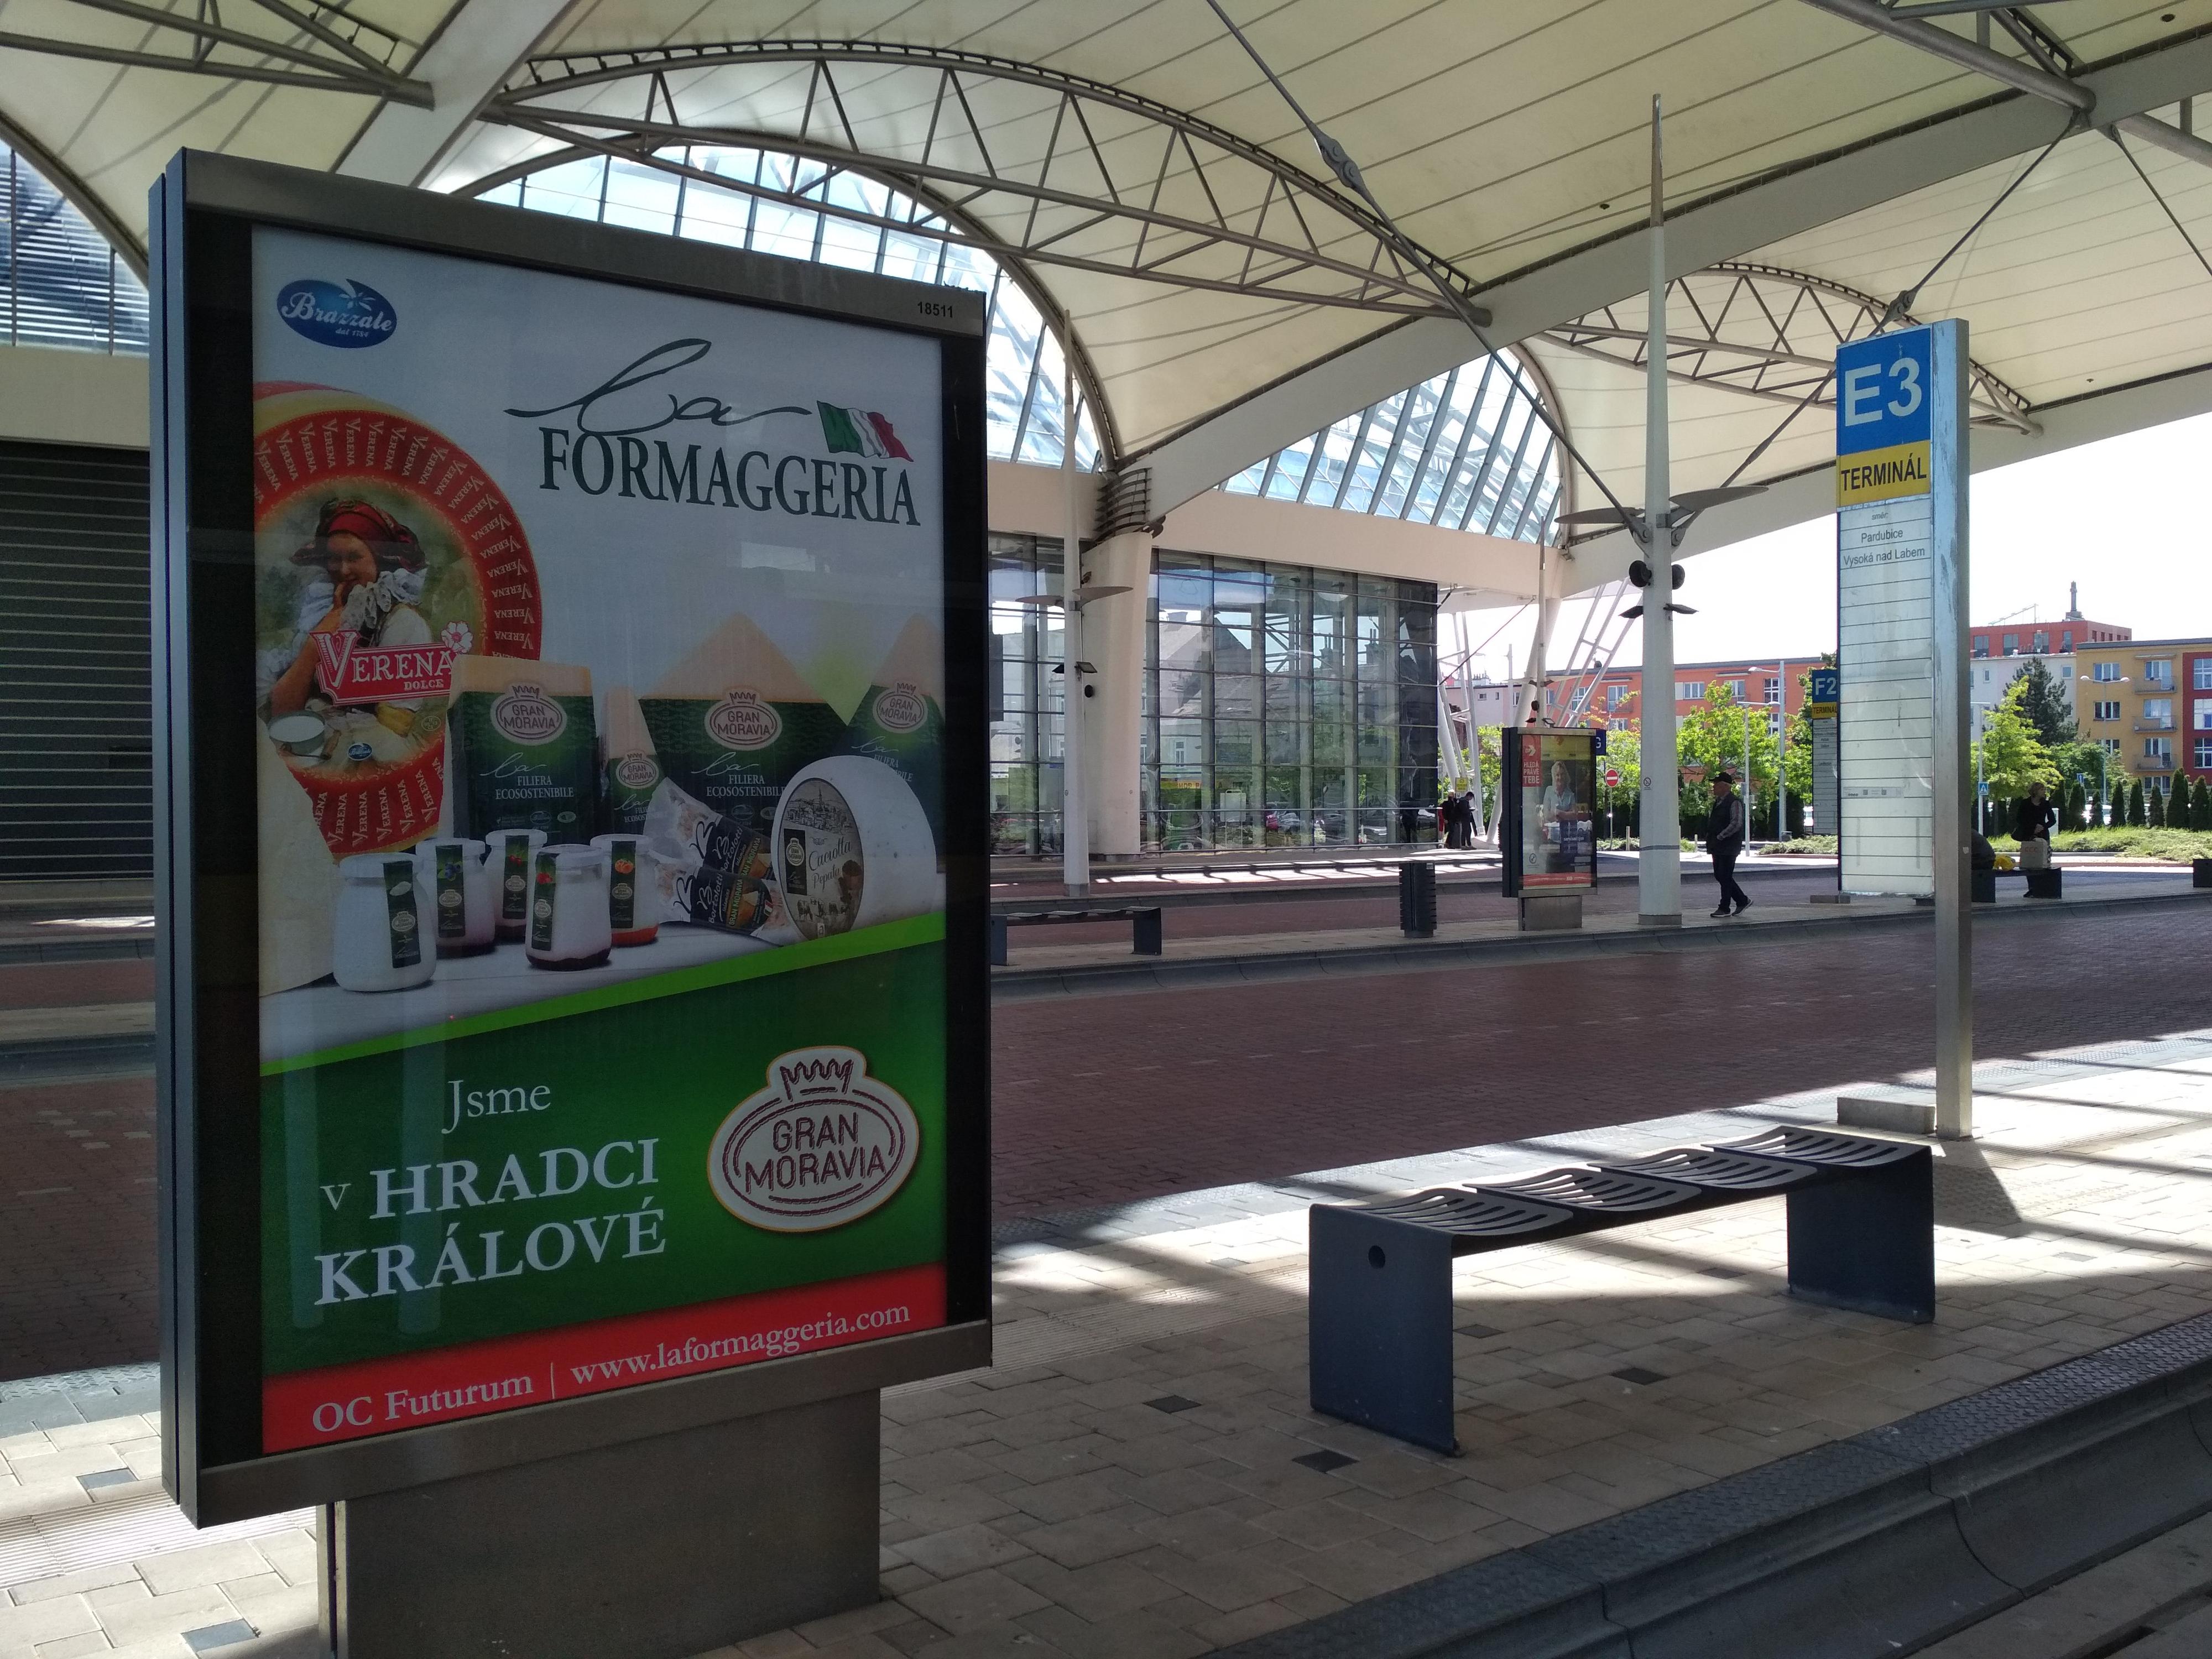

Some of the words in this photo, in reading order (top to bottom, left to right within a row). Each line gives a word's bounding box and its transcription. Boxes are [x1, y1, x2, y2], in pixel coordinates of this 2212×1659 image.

[281, 291, 392, 331] Brazzale
[917, 301, 953, 318] 18511
[1845, 357, 1922, 427] E3
[539, 426, 921, 526] FORMAGGERIA
[1841, 453, 1927, 492] TERMINÁL
[1861, 529, 1903, 543] Pardubice
[1843, 552, 1874, 567] Vysoká
[1876, 550, 1892, 562] nad
[1895, 547, 1925, 559] Labem
[314, 630, 452, 688] VERENA
[404, 679, 444, 691] DOLCE
[1815, 677, 1837, 695] F2
[512, 705, 545, 716] GRAN
[890, 698, 914, 711] GRAN
[503, 716, 556, 730] MORAVIA
[728, 711, 760, 723] GRAN
[880, 707, 917, 723] MORAVIA
[717, 723, 770, 735] MORAVIA
[624, 772, 653, 781] MORAVIA
[628, 765, 646, 773] GRAN
[517, 775, 552, 786] FILIERA
[728, 774, 765, 784] FILIERA
[495, 787, 575, 800] ECOSOSTENIBILE
[708, 873, 723, 924] Bortolotti
[732, 879, 744, 907] MORAVIA
[729, 907, 738, 926] GRAN
[441, 1079, 551, 1134] Jsme
[773, 1112, 859, 1154] GRAN
[745, 1145, 886, 1193] MORAVIA
[320, 1183, 352, 1212] v
[369, 1138, 659, 1219] HRADCI
[314, 1196, 666, 1306] KRÁLOVÉ
[312, 1395, 373, 1432] OC
[384, 1375, 534, 1421] Futurum
[570, 1305, 911, 1385] www.laformaggeria.com
